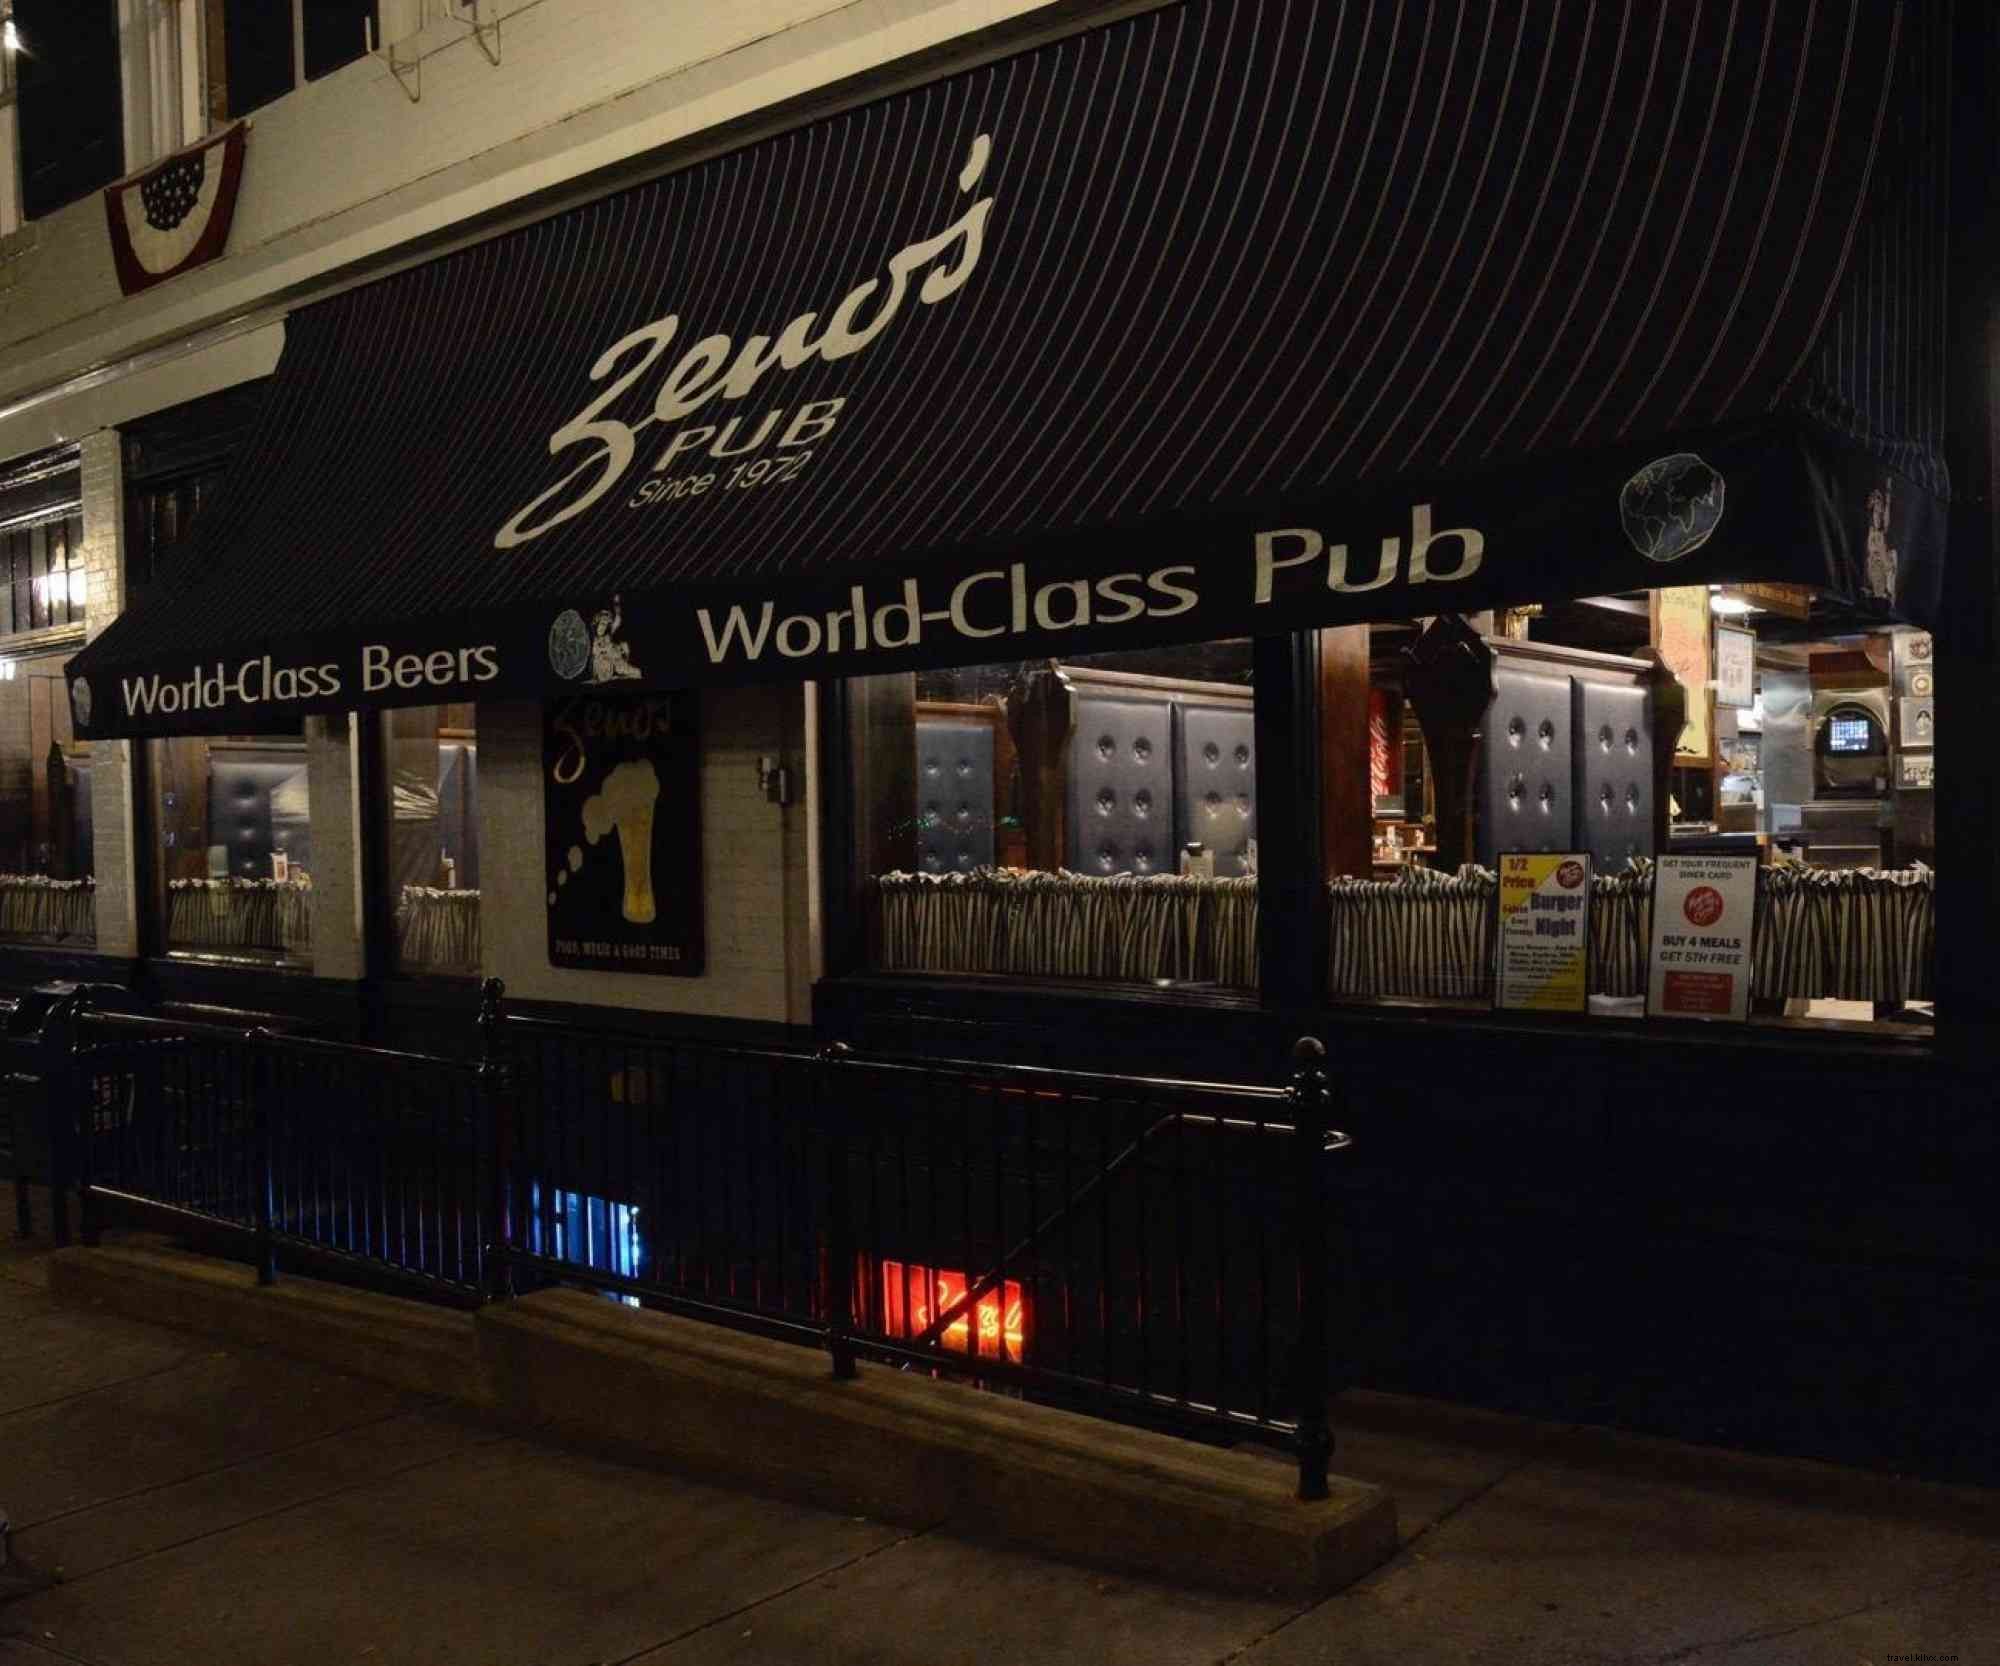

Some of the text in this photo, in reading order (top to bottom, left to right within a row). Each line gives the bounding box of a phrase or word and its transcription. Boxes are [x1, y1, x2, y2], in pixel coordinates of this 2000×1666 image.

[654, 397, 847, 472] PUB
[628, 450, 813, 508] Since 1972
[695, 503, 1486, 664] World-Class Pub
[121, 644, 500, 716] World-Class Beers
[1509, 858, 1529, 871] 1/2
[1663, 859, 1679, 868] GET
[1502, 876, 1536, 888] Price
[1708, 871, 1733, 880] CARD
[1531, 893, 1584, 912] Burger
[1535, 917, 1576, 937] Night
[1663, 935, 1741, 949] BUY 4 MEALS
[1660, 952, 1742, 965] GET 5TH FREE
